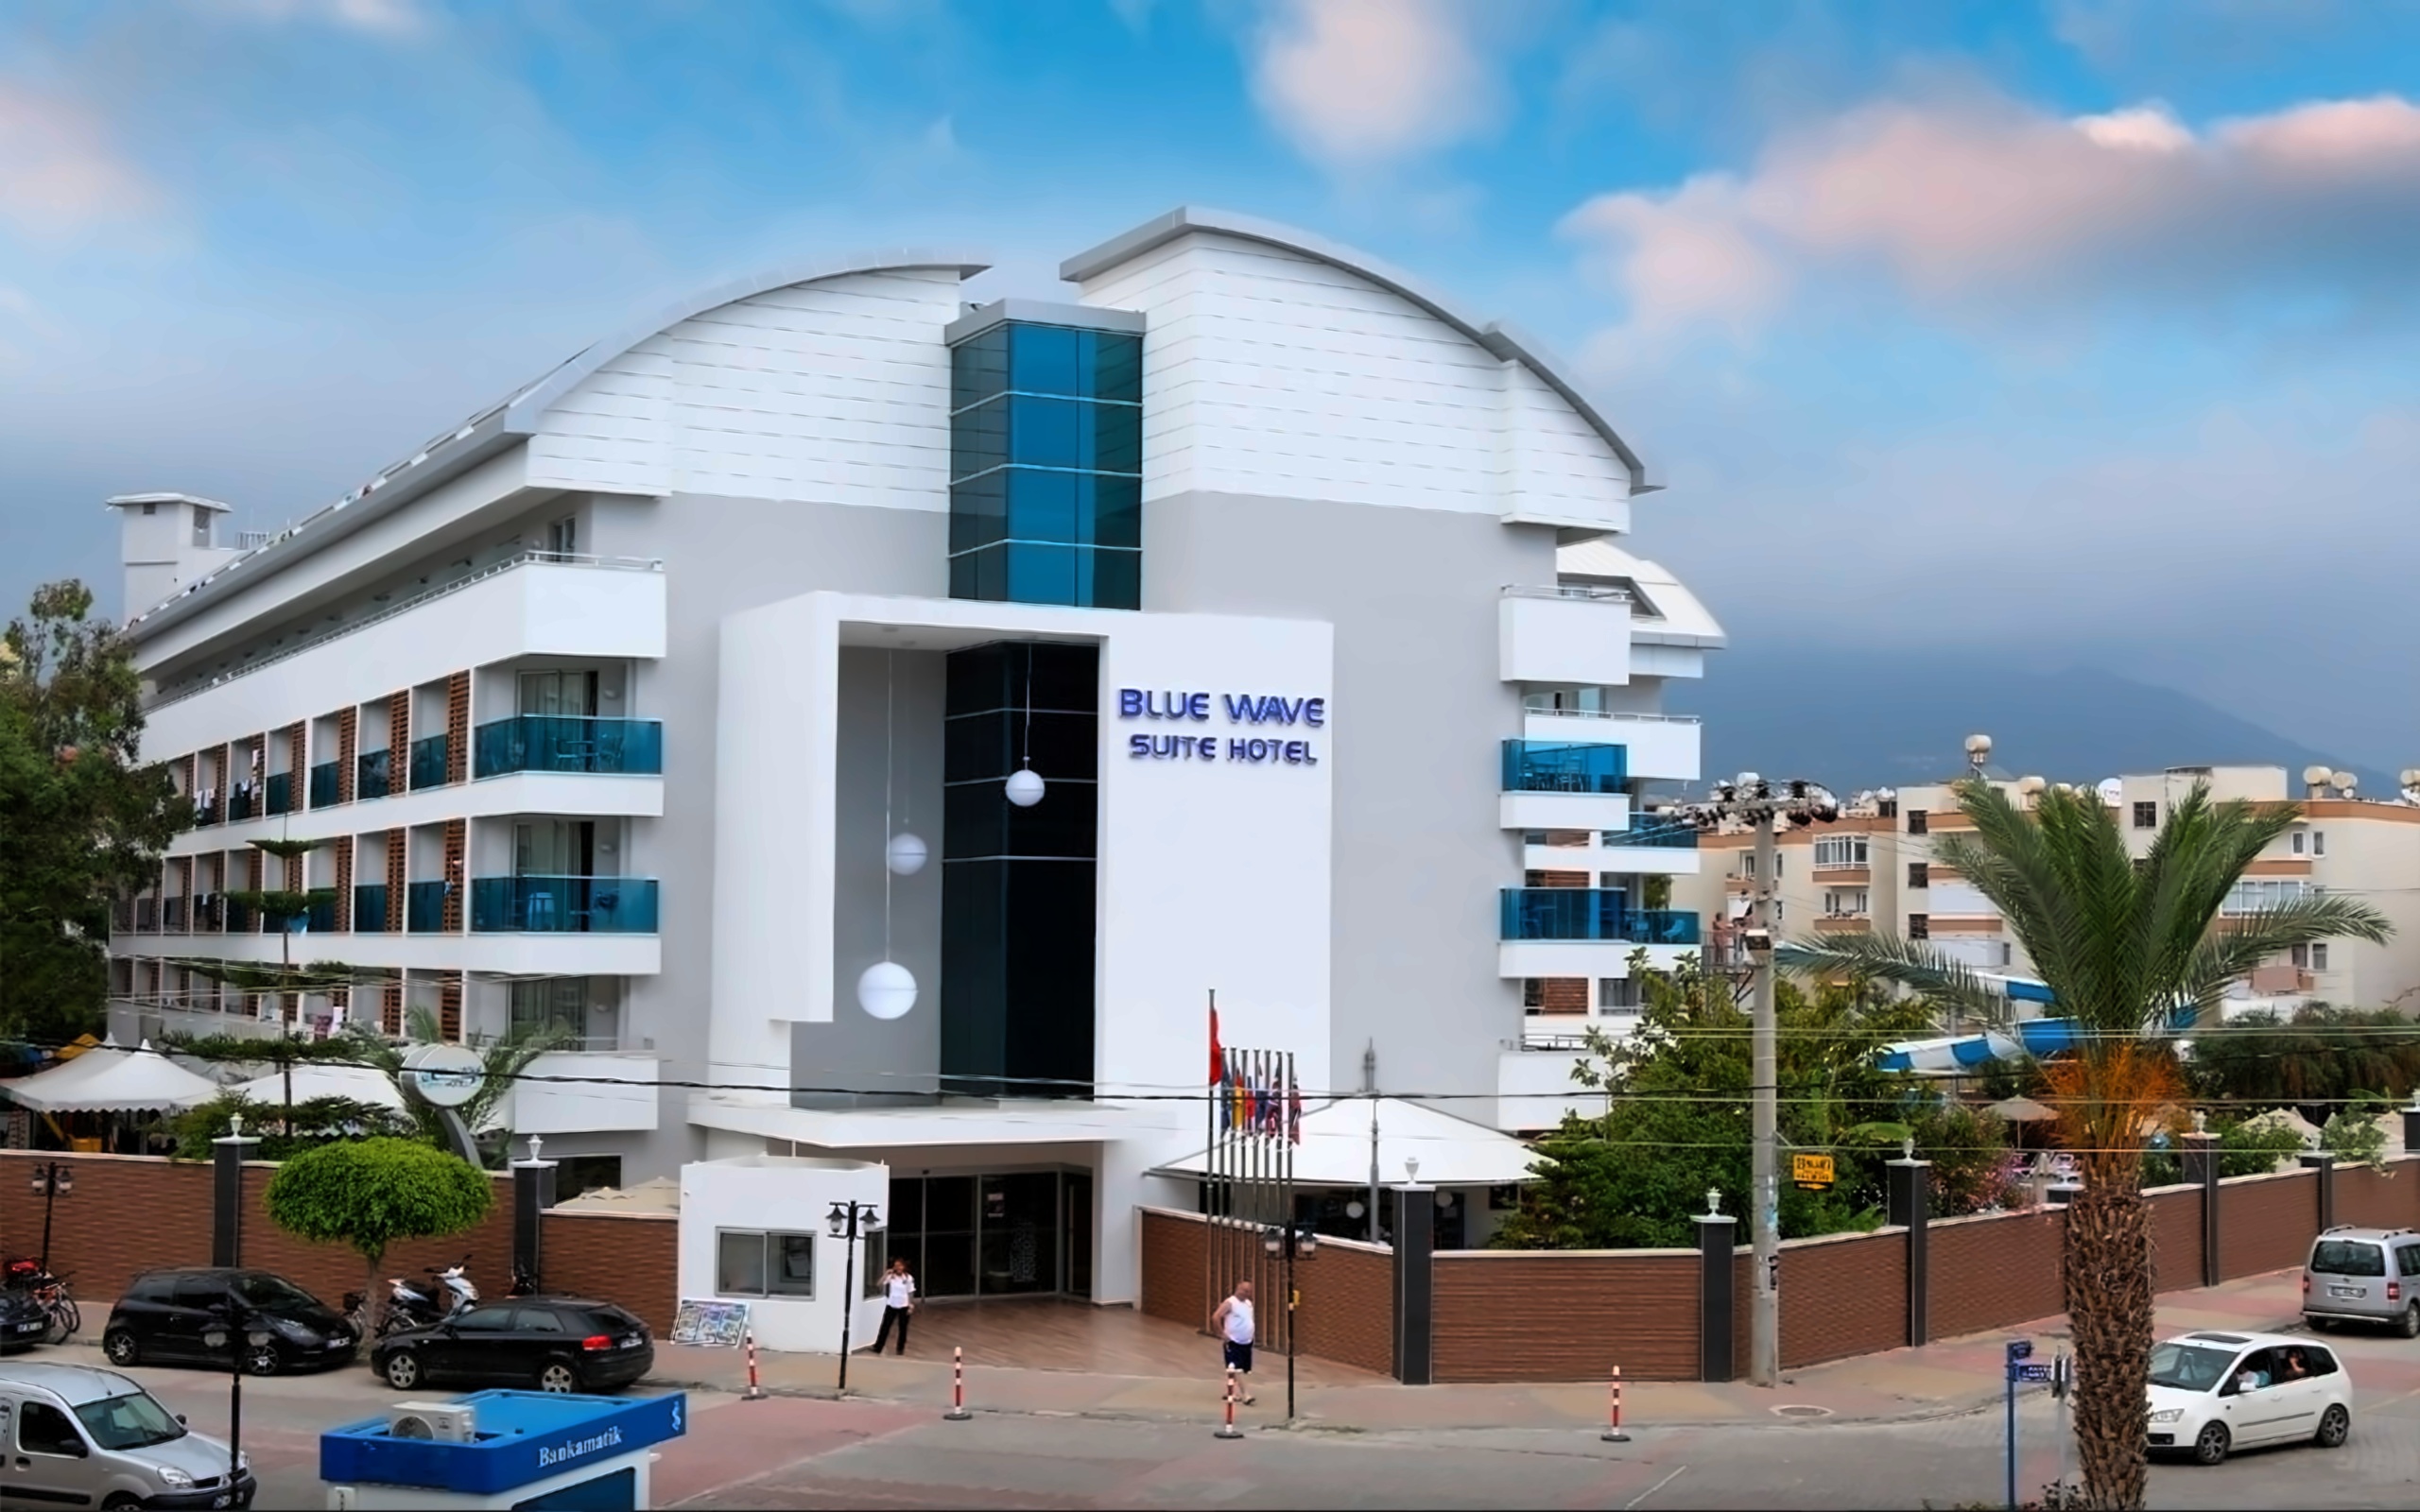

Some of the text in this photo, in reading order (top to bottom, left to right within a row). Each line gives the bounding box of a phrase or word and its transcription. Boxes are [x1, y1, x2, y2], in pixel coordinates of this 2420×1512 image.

[1119, 688, 1325, 726] BLUE WAVE
[1130, 733, 1318, 765] SUITE HOTEL
[538, 1425, 622, 1468] Bankamatik
